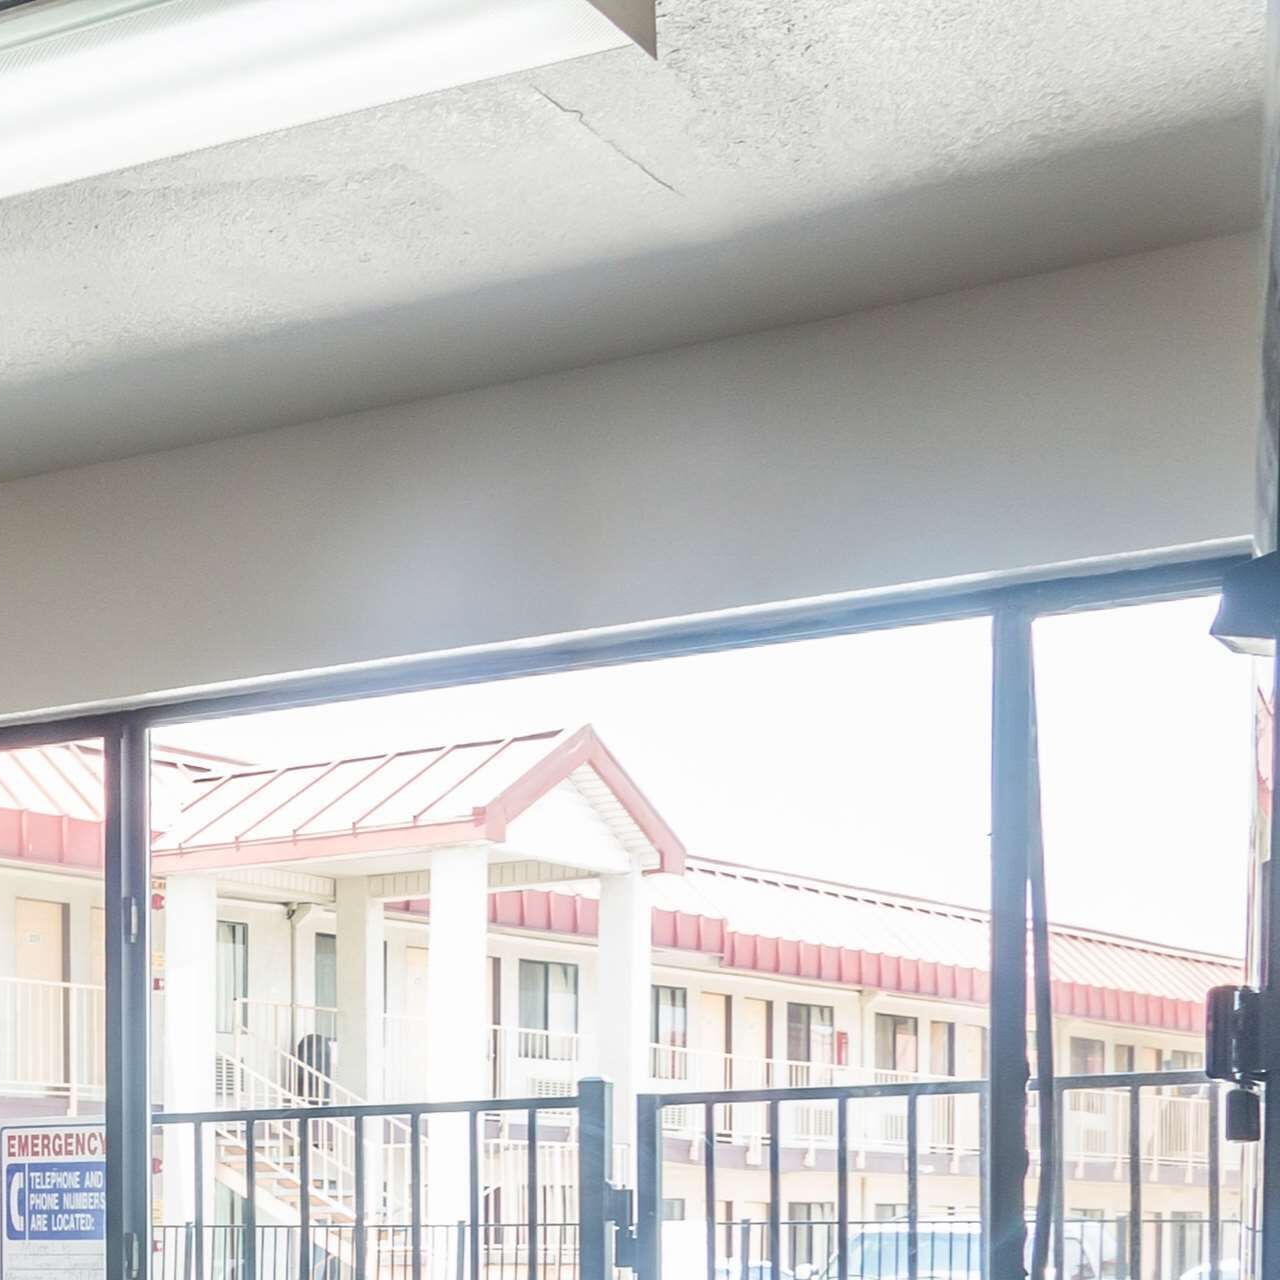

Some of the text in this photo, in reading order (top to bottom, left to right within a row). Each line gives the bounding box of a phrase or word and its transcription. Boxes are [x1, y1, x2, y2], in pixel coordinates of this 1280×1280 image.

[29, 1171, 103, 1189] TELEPHONE AND
[29, 1193, 59, 1210] PHONE
[30, 1214, 96, 1232] ARE LOCATED:
